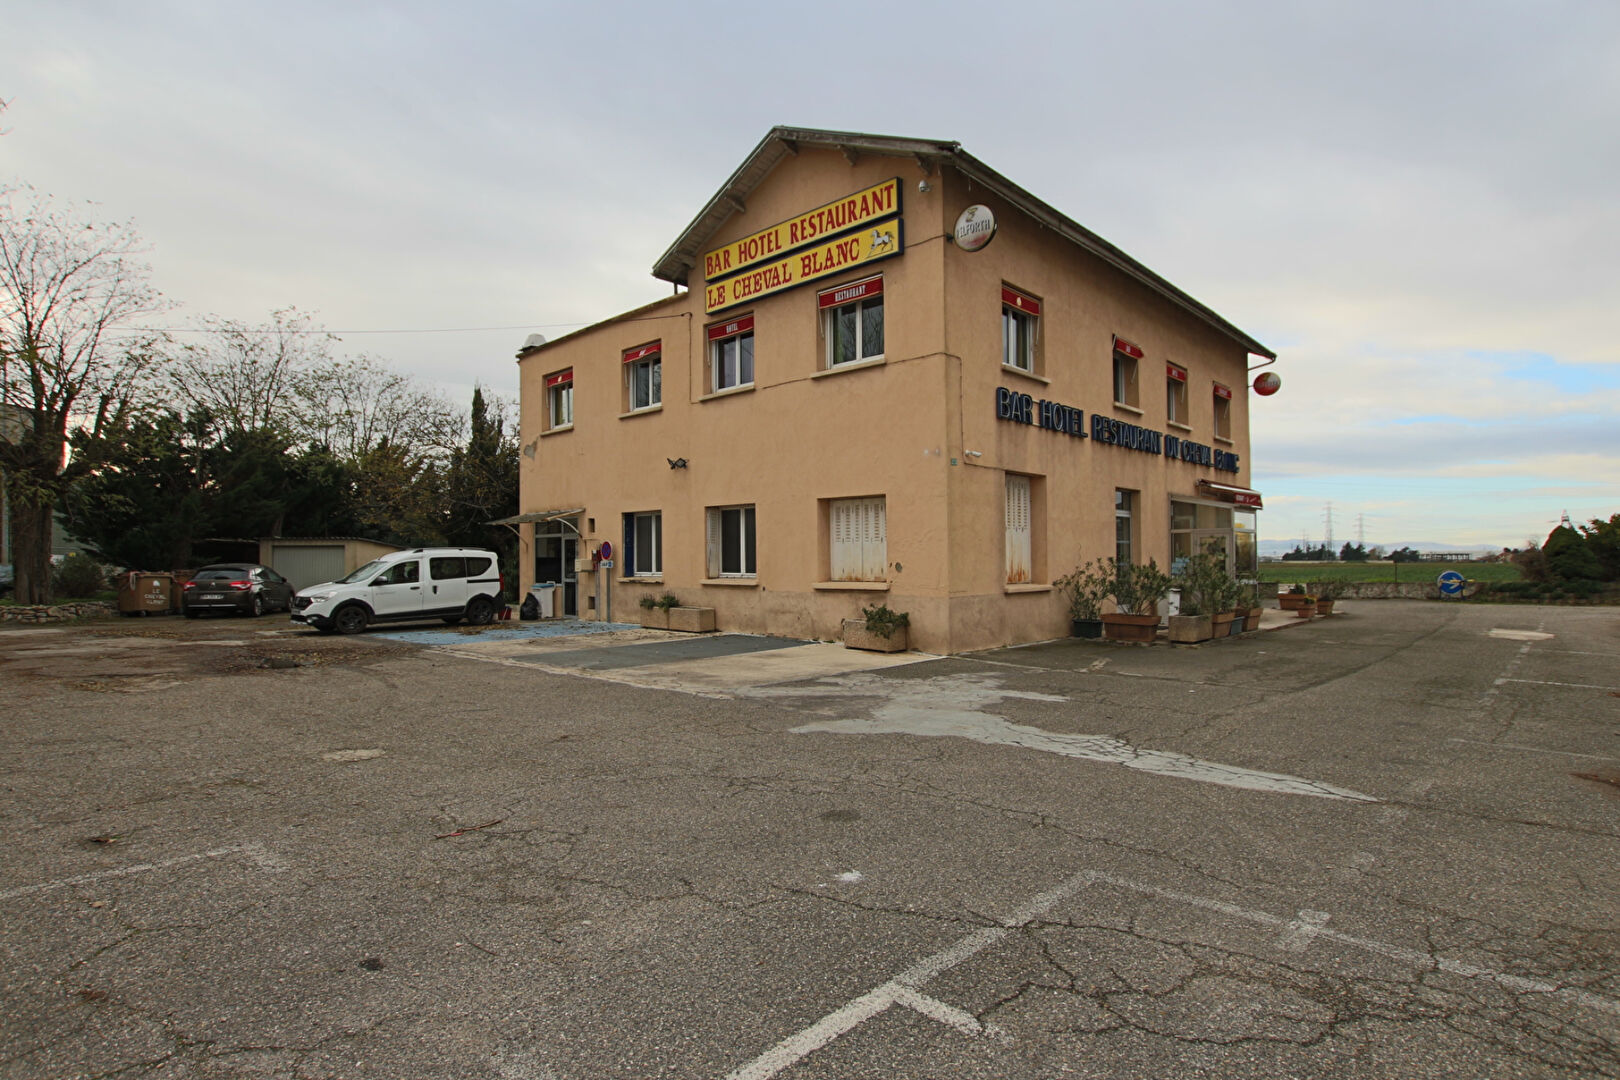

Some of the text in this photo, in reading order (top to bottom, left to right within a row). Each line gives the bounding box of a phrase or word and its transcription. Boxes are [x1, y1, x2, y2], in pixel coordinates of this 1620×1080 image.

[706, 184, 895, 276] BAR HOTEL RESTAURANT
[707, 238, 860, 309] LE CHEVAL BLANC
[835, 285, 865, 302] RESTAURANT
[996, 387, 1033, 425] BAR
[1039, 399, 1088, 438] HOTEL
[1091, 413, 1163, 455] RESTAURANT
[1165, 434, 1180, 460] DU
